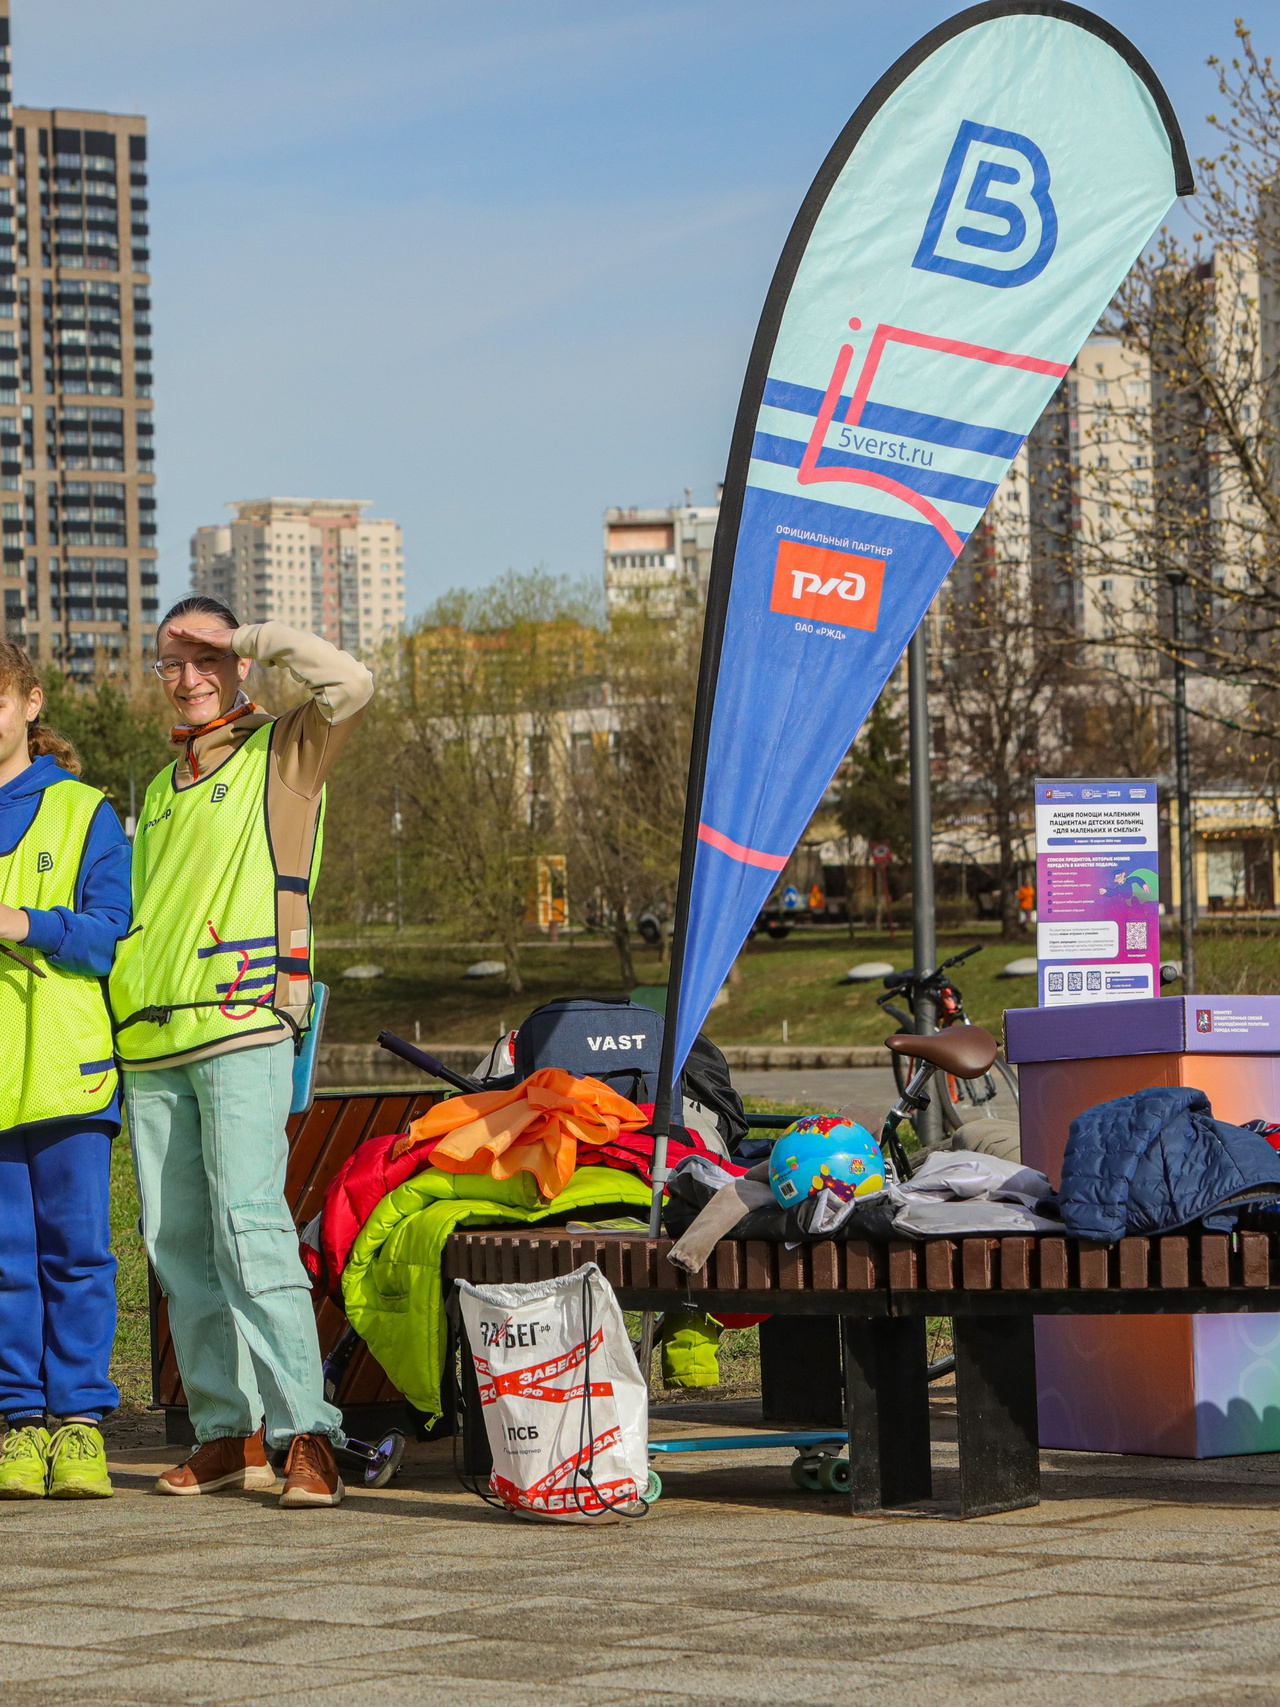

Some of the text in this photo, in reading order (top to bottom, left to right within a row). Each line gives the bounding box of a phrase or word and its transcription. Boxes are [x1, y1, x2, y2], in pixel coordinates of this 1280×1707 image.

[838, 427, 933, 467] 5verst.ru
[775, 524, 893, 557] ОФИЦИАЛЬНЫЙ ПАРТНЕР
[795, 622, 846, 641] ОАО «РЖД»
[586, 1034, 646, 1051] VAST
[507, 1425, 539, 1441] ПСБ
[537, 1461, 574, 1492] 2023
